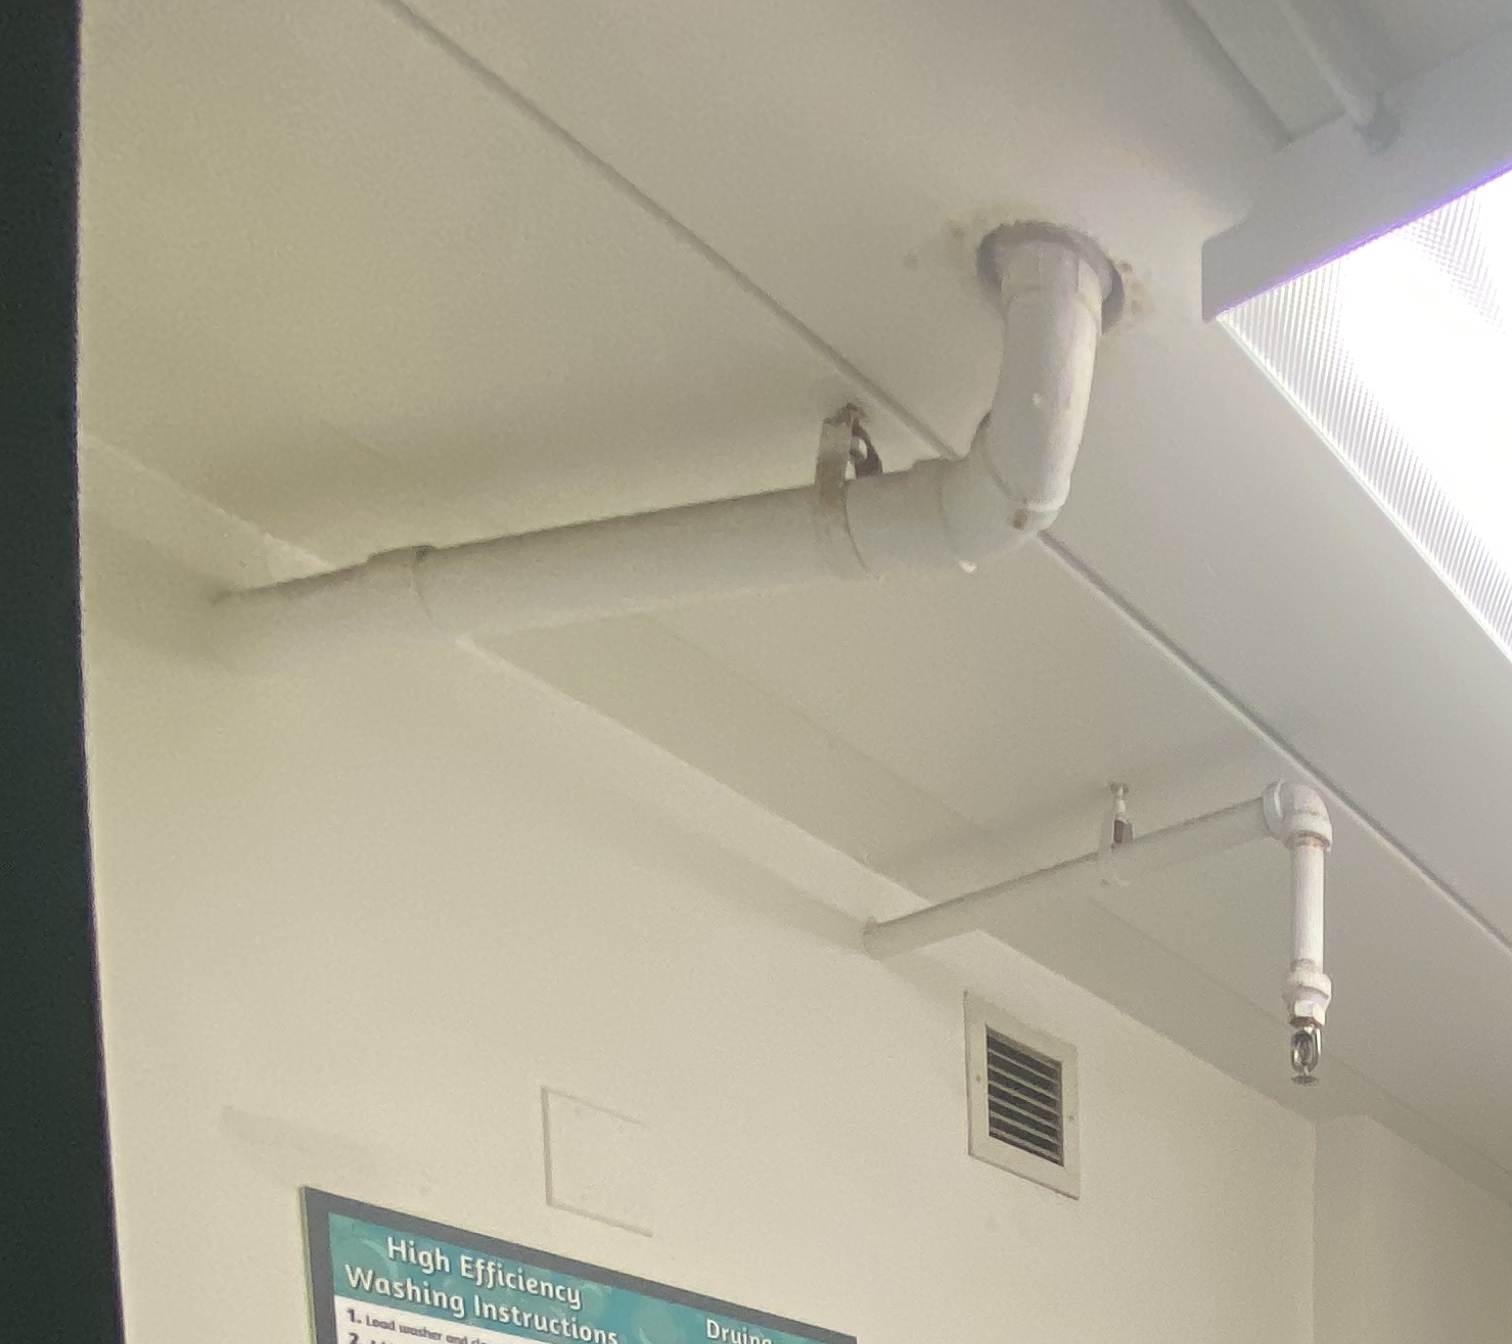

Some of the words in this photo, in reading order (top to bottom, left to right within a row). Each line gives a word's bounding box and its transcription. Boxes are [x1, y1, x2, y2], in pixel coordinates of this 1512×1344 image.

[345, 1263, 465, 1320] Washing
[386, 1235, 451, 1276] High
[460, 1254, 582, 1312] Efficiency
[347, 1309, 362, 1324] 1.
[366, 1315, 395, 1332] Load
[400, 1325, 441, 1341] washer
